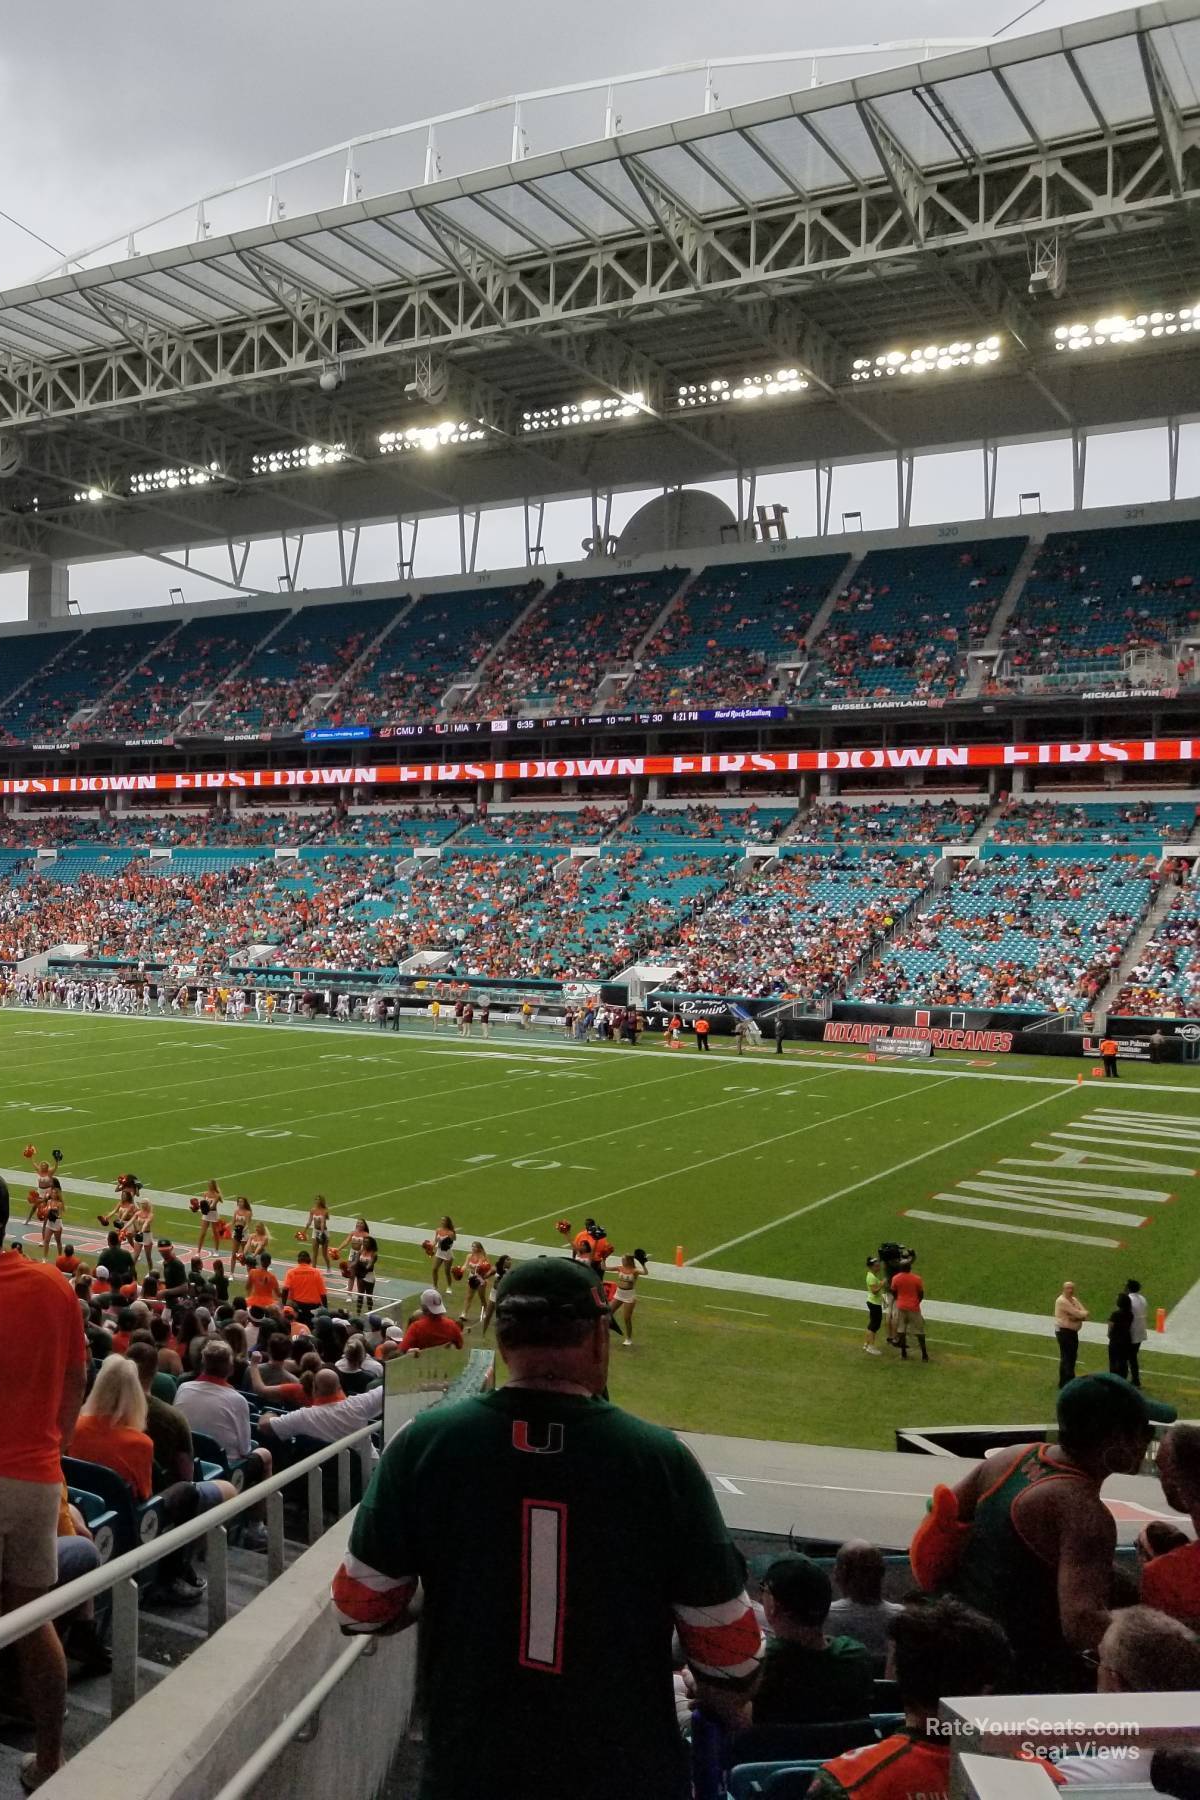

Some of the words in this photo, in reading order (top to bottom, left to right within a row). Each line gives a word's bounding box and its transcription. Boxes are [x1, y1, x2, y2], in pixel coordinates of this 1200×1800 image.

[1082, 690, 1128, 699] MICHAEL
[1131, 689, 1160, 698] IRVIN
[831, 702, 871, 711] RUSSELL
[873, 699, 927, 709] MARYLAND
[652, 714, 662, 722] 30
[673, 712, 687, 721] 4:21
[688, 711, 698, 720] PM
[714, 711, 730, 719] Hard
[730, 710, 745, 719] Rock
[745, 708, 771, 719] Stadium
[517, 720, 534, 729] 6:35
[606, 717, 616, 725] 10
[396, 726, 415, 735] CMU
[417, 726, 423, 734] 0
[454, 724, 469, 732] MIA
[476, 723, 481, 731] 7
[818, 747, 968, 769] DOWN
[520, 758, 644, 779] DOWN
[274, 767, 377, 785] DOWN
[71, 775, 156, 791] DOWN
[823, 1022, 890, 1044] MIAMI
[892, 1025, 1014, 1053] HURRICANES
[512, 1420, 564, 1454] U
[519, 1498, 568, 1675] 1
